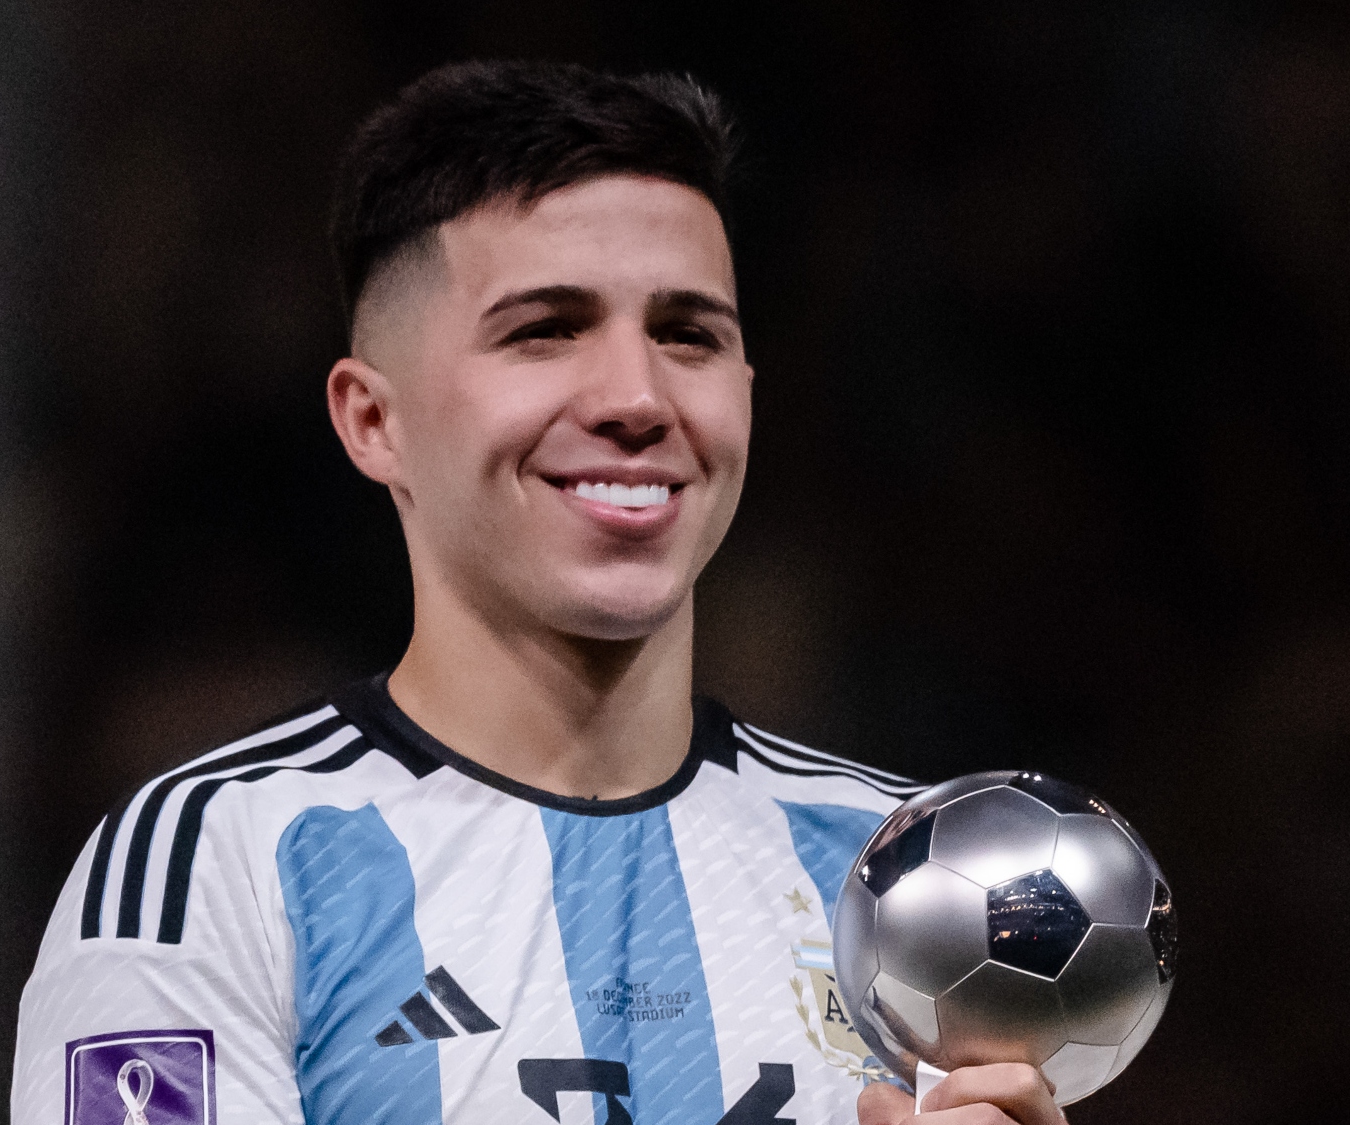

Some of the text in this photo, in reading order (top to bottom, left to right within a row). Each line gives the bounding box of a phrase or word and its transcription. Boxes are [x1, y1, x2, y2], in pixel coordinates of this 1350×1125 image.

[615, 977, 651, 994] FANCE
[657, 991, 692, 1006] 2022
[627, 1007, 684, 1022] STADIUM
